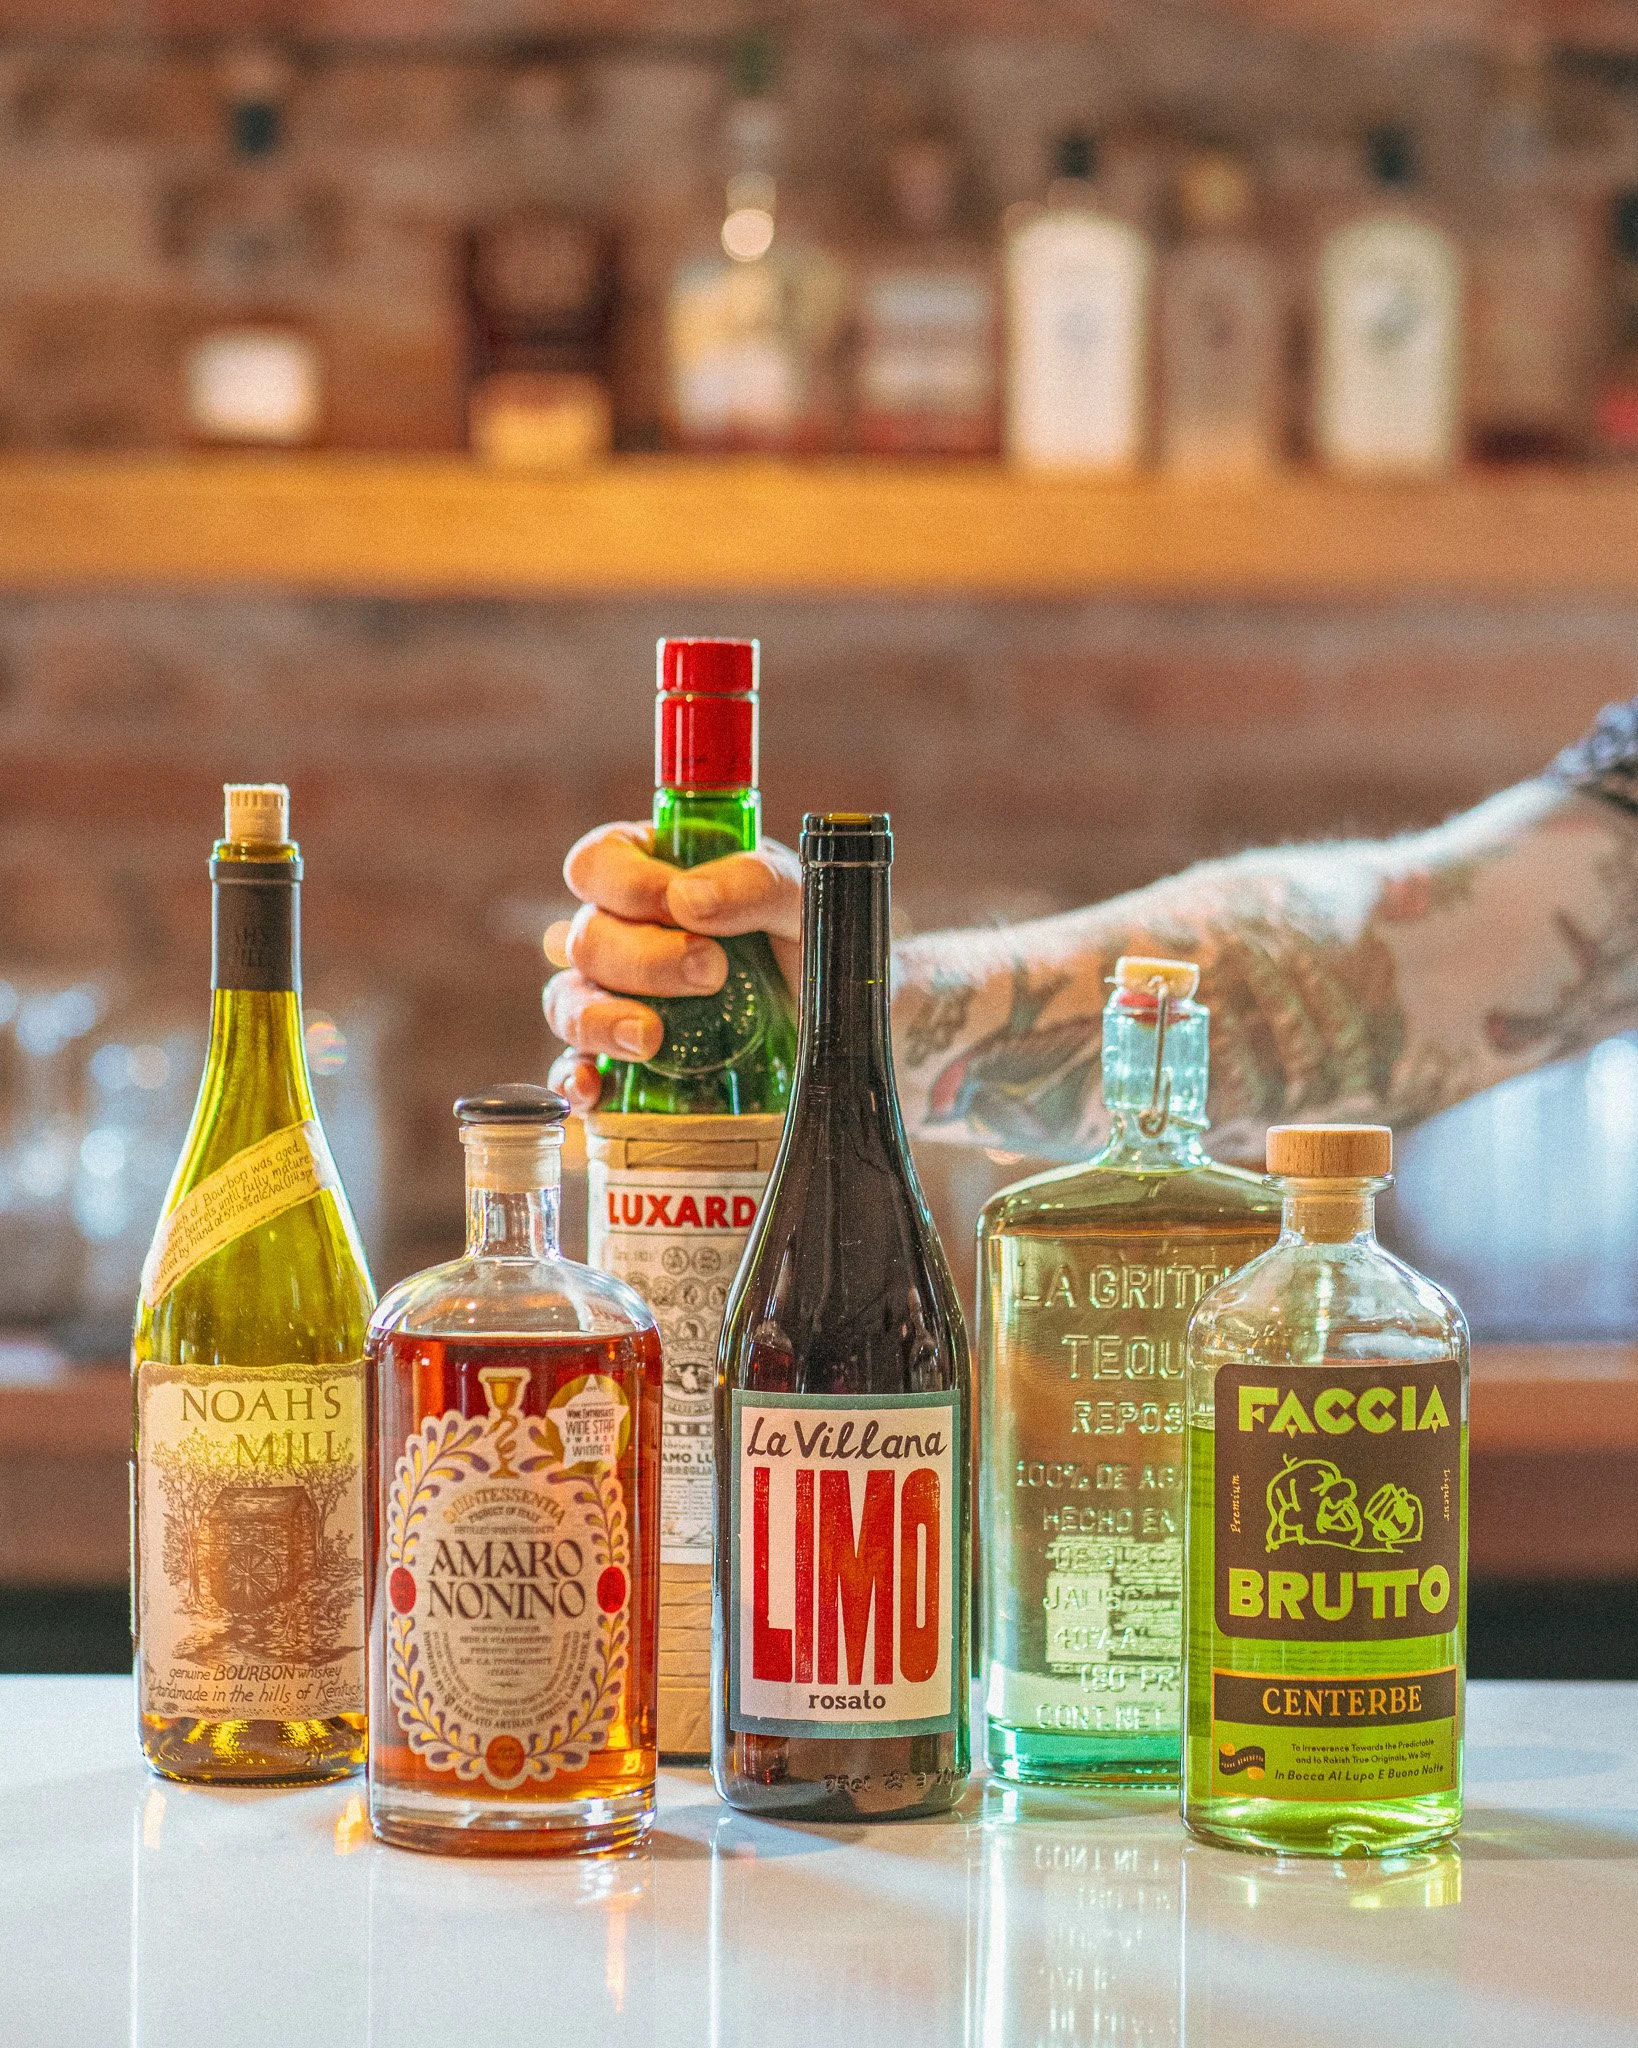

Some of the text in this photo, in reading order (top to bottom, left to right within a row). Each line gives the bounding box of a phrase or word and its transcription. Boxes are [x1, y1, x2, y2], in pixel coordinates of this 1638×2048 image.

[202, 1170, 248, 1208] Bourbon
[251, 1157, 273, 1175] was
[275, 1140, 300, 1168] aged
[219, 1187, 241, 1211] until
[242, 1174, 269, 1197] fully
[271, 1154, 310, 1178] mature
[608, 1191, 757, 1228] LUXARD
[189, 1219, 214, 1247] hand
[1014, 1263, 1230, 1310] LA GRITO
[1061, 1333, 1185, 1381] TEQU
[181, 1385, 341, 1423] NOAH'S
[1070, 1400, 1185, 1435] REPOS
[1237, 1384, 1450, 1439] FACCIA
[234, 1430, 341, 1466] MILL
[746, 1416, 948, 1459] La Villana
[1016, 1461, 1182, 1492] 100% DE AG
[1441, 1467, 1451, 1523] Liqueur
[1043, 1505, 1133, 1534] HECHO
[1230, 1474, 1242, 1534] Premium
[429, 1539, 584, 1580] AMARO
[752, 1467, 940, 1686] LIMO
[427, 1579, 586, 1620] NONINO
[1228, 1564, 1451, 1622] BRUTTO
[167, 1662, 342, 1686] genuine BOURBON whiskey
[212, 1685, 227, 1703] in
[228, 1683, 255, 1703] the
[259, 1682, 292, 1704] hills
[296, 1683, 315, 1701] of
[808, 1690, 887, 1711] rosato
[1262, 1685, 1423, 1717] CENTERBE
[1291, 1737, 1434, 1752] To Irreverence Towards the Predictable
[1295, 1750, 1432, 1764] and to Rakish True Originals, We Say
[1275, 1762, 1444, 1783] In Bocca Al Lupo E Buona Notte
